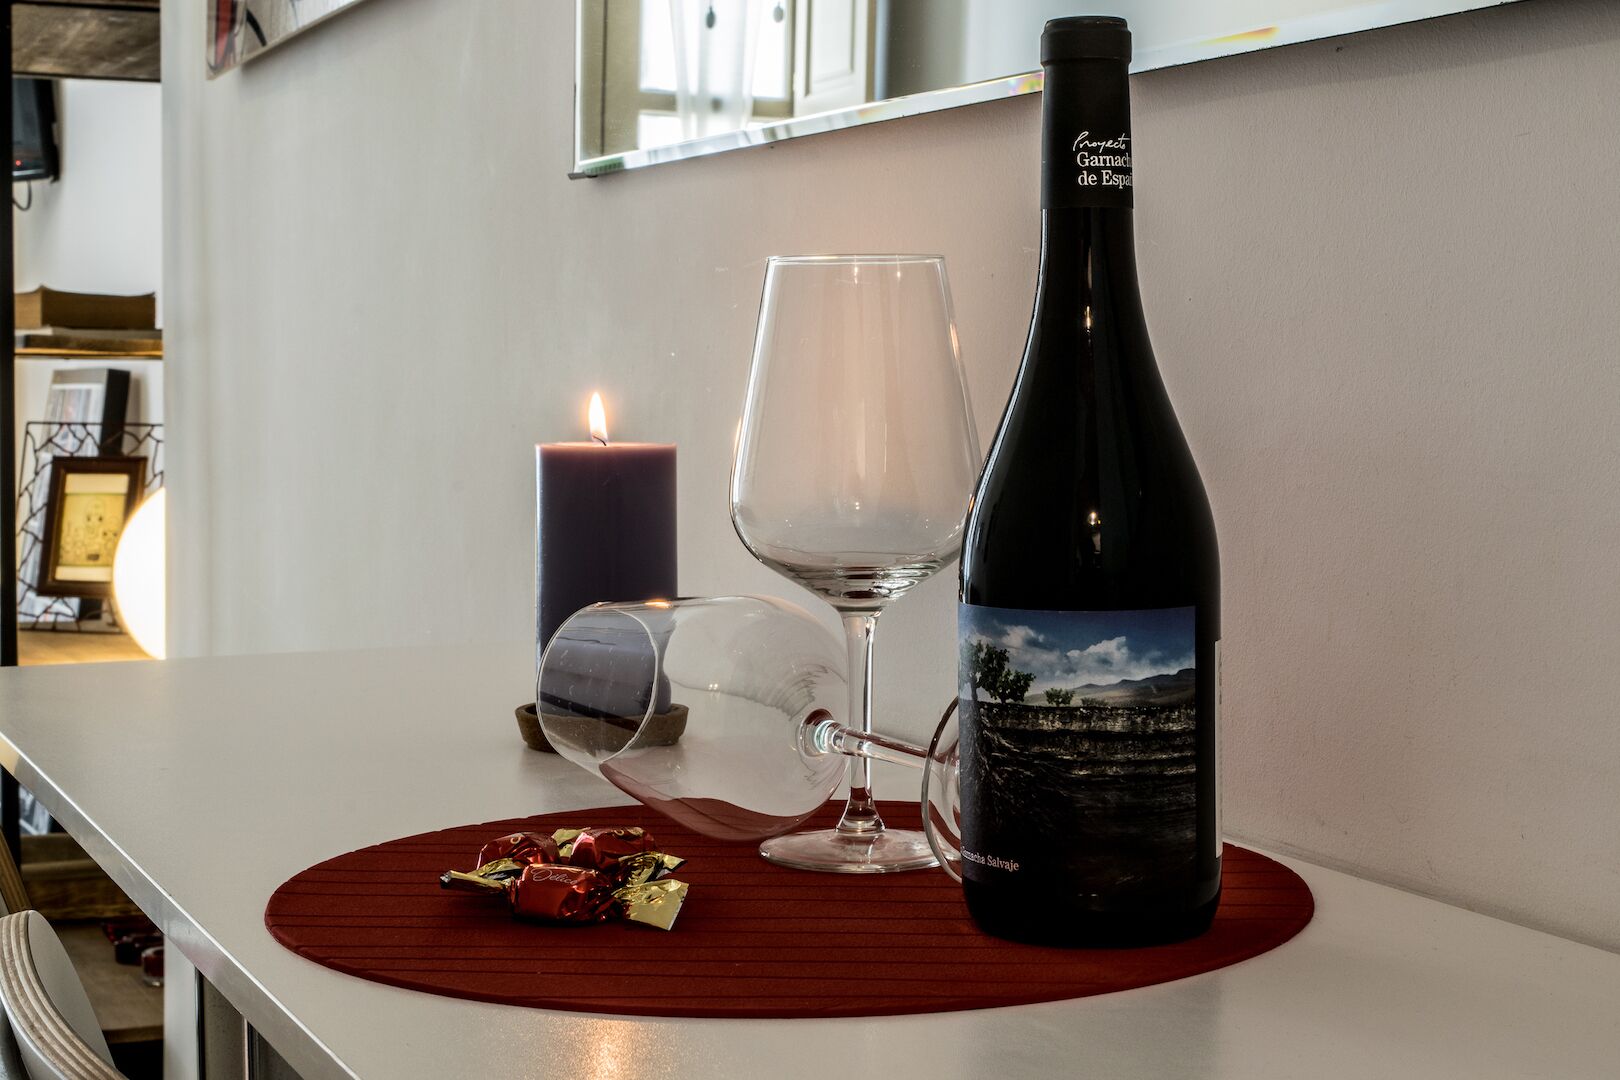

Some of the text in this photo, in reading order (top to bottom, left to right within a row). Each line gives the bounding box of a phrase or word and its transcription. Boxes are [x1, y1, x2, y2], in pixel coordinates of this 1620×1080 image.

[1076, 152, 1132, 167] Garnach
[1077, 170, 1098, 186] de
[987, 855, 1019, 872] Salvaje
